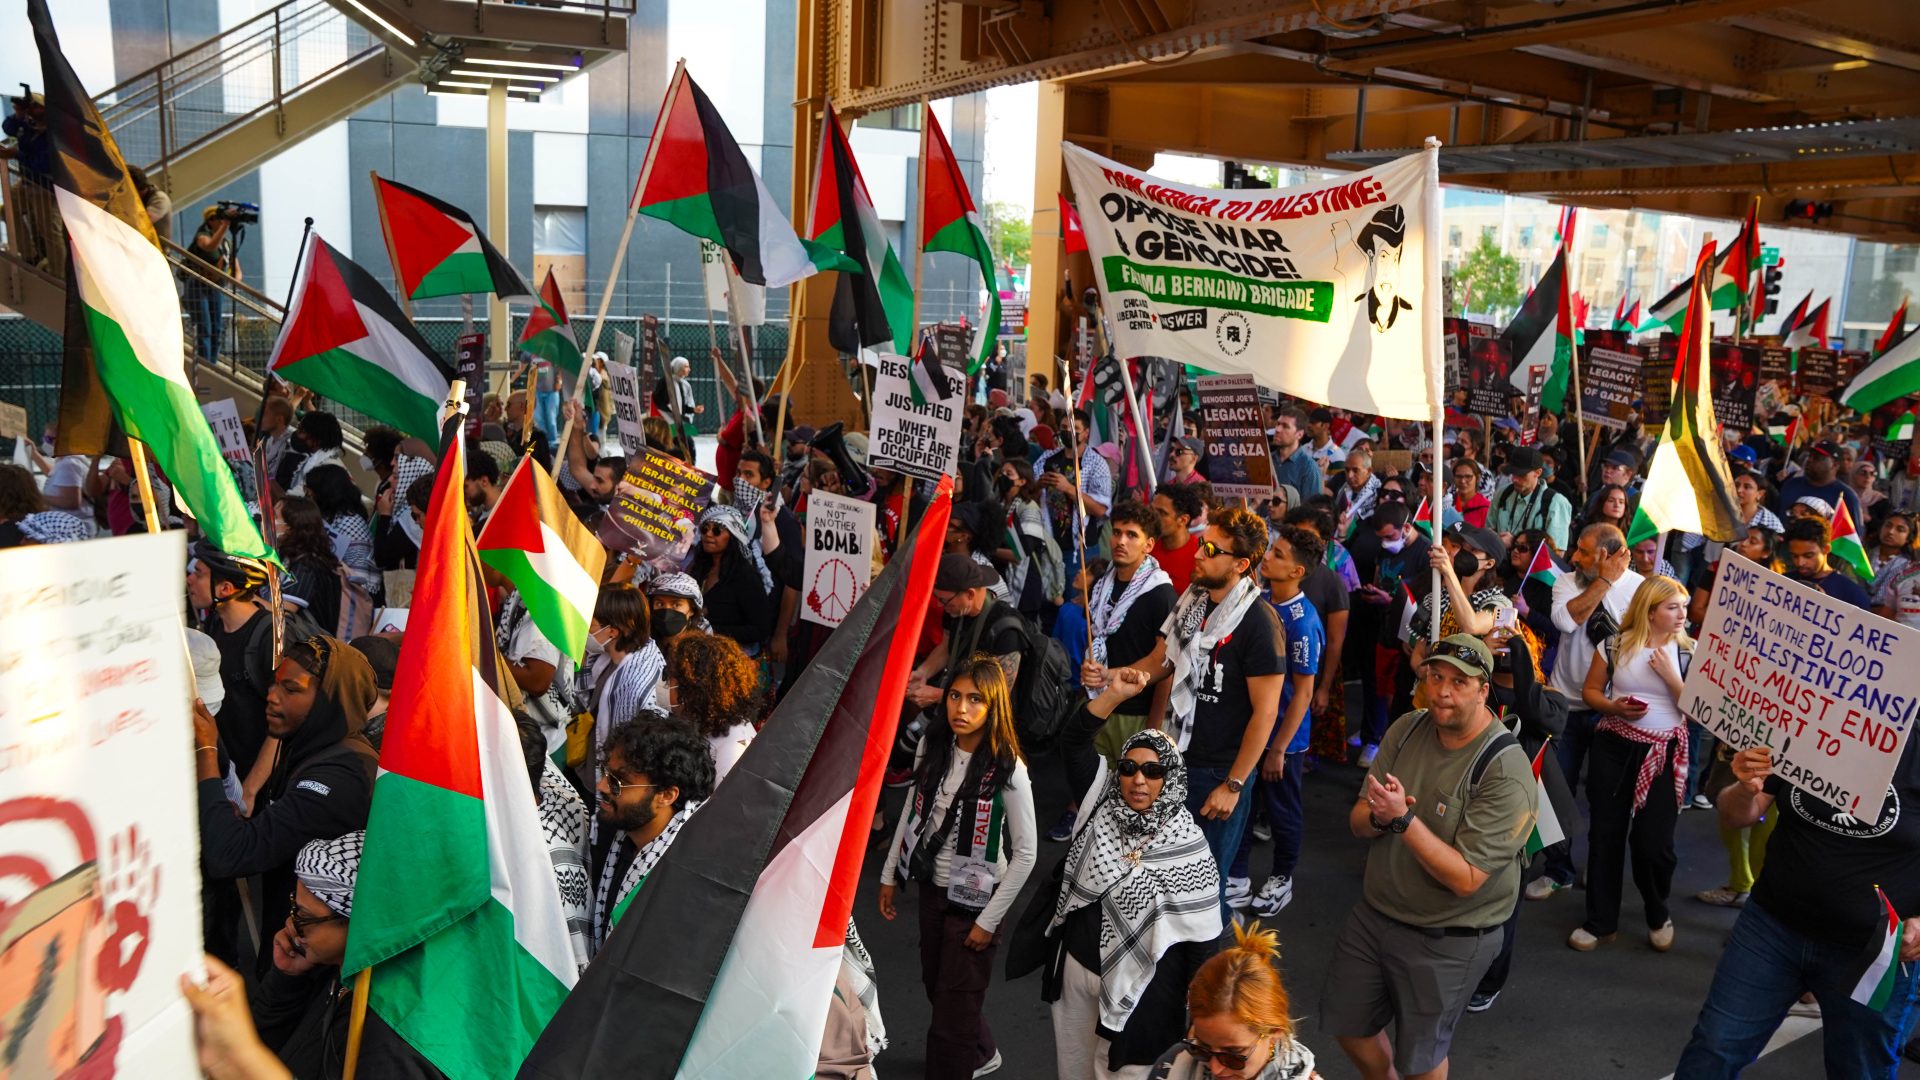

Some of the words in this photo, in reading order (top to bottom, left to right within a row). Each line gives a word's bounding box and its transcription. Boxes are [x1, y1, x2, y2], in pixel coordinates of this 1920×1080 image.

[1146, 184, 1217, 217] AFRICA
[1217, 200, 1251, 220] TO
[1247, 175, 1386, 222] PALESTINE:
[1203, 220, 1292, 253] WAR
[1135, 230, 1304, 281] GENOCIDE!
[1171, 275, 1248, 303] BERNAWI
[1249, 284, 1316, 313] BRIGADE
[1586, 378, 1600, 387] THE
[1600, 382, 1633, 394] BUTCHER
[1589, 366, 1635, 384] LEGACY:
[1202, 395, 1235, 403] GENOCIDE
[1235, 394, 1255, 402] JOE'S
[1584, 387, 1599, 397] OF
[1599, 391, 1630, 404] GAZA
[1714, 399, 1748, 410] MOCRATS
[898, 418, 937, 440] WHEN
[1203, 407, 1259, 422] LEGACY:
[878, 428, 925, 451] PEOPLE
[928, 442, 952, 459] ARE
[1205, 428, 1223, 437] THE
[1224, 428, 1262, 437] BUTCHER
[881, 442, 947, 471] OCCUPIED!
[1208, 443, 1226, 456] OF
[1228, 443, 1266, 457] GAZA
[641, 466, 675, 487] ISRAEL
[678, 482, 698, 497] ARE
[645, 453, 664, 467] THE
[665, 461, 683, 476] U.S.
[685, 470, 706, 486] AND
[625, 473, 704, 513] INTENTIONALLY
[633, 492, 685, 519] STARVING
[823, 500, 834, 509] ARE
[619, 500, 688, 534] PALESTINIAN
[623, 514, 675, 542] CHILDREN
[814, 516, 857, 533] ANOTHER
[826, 510, 847, 521] NOT
[814, 528, 862, 555] BOMB!
[1723, 562, 1760, 600] SOME
[1760, 581, 1845, 637] ISRAELIS
[1848, 623, 1899, 656] ARE
[1718, 586, 1768, 630] DRUNK
[1808, 633, 1884, 682] BLOOD
[1722, 617, 1738, 636] OF
[1739, 627, 1917, 732] PALESTINIANS!
[1699, 658, 1726, 690] ALL
[1727, 677, 1809, 738] SUPPORT
[1816, 729, 1842, 757] TO
[1707, 632, 1731, 662] THE
[1762, 670, 1836, 721] MUST
[1840, 709, 1899, 754] END
[1690, 695, 1713, 725] NO
[1714, 718, 1760, 750] MORE
[1793, 791, 1801, 806] YOU
[1798, 806, 1814, 822] WILL
[1815, 819, 1844, 833] NEVER
[1871, 815, 1894, 834] ALONE
